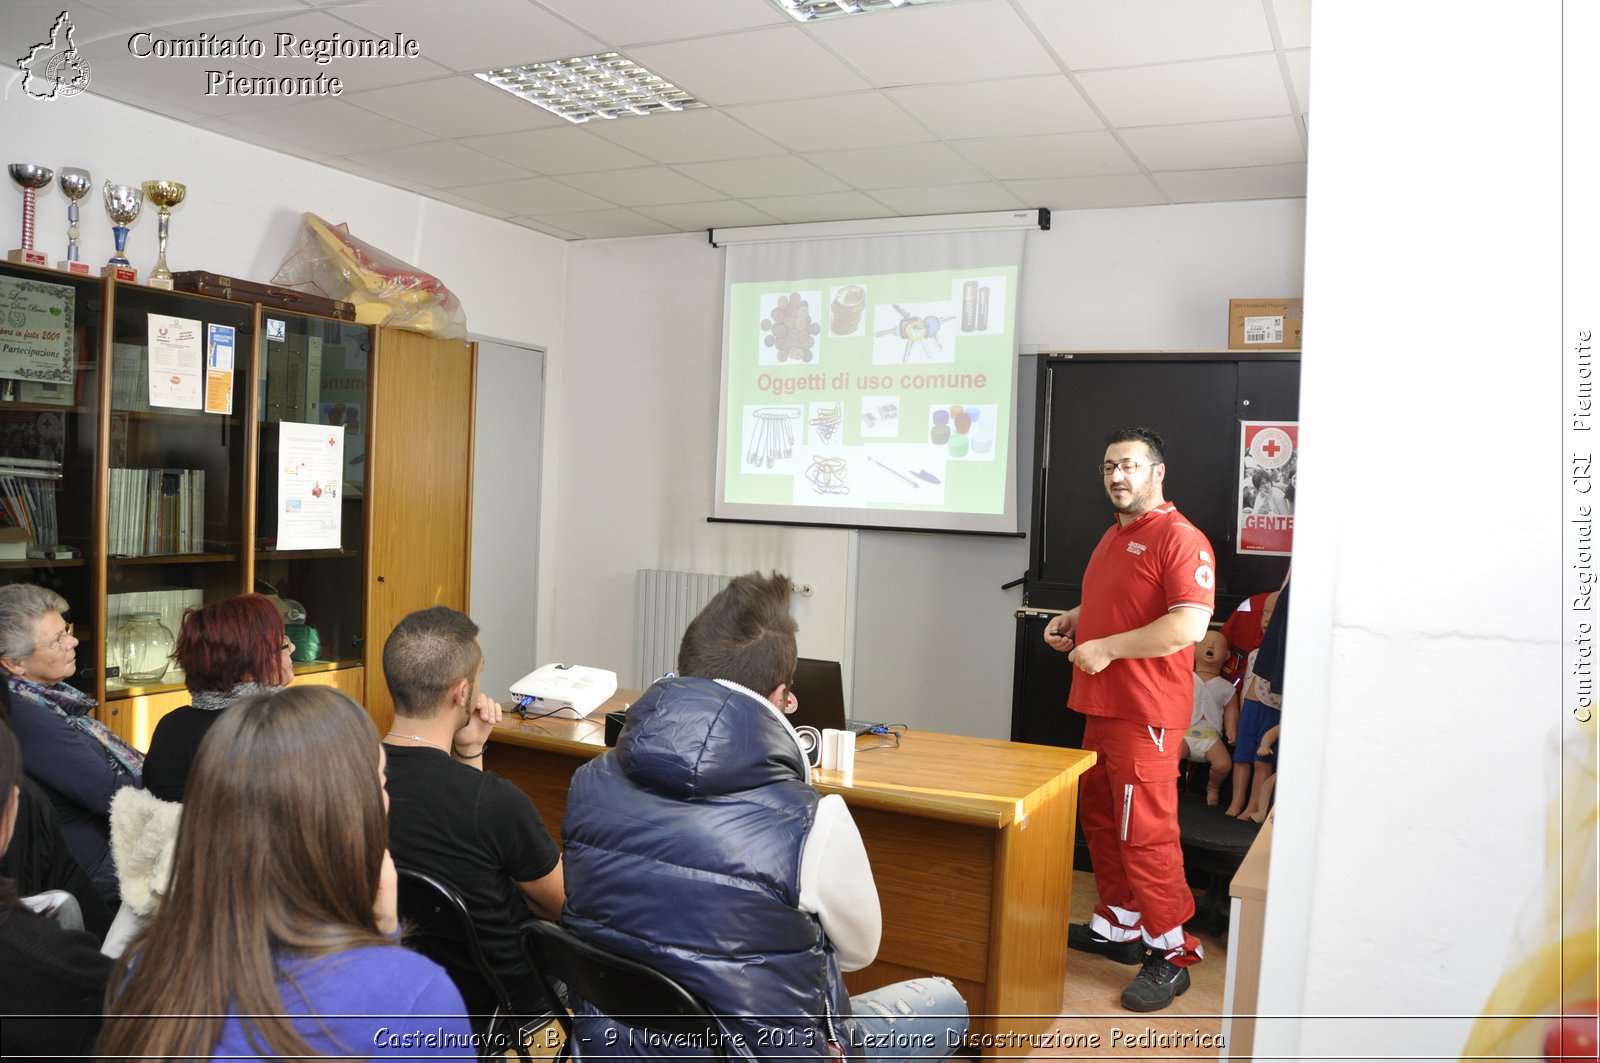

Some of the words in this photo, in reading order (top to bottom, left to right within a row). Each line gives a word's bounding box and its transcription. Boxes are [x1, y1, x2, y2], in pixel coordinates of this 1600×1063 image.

[24, 329, 39, 341] festa
[42, 330, 61, 341] 2009
[2, 343, 61, 358] Partecipazione
[757, 372, 827, 395] Oggetti
[831, 371, 850, 390] di
[856, 375, 894, 390] uso
[900, 372, 987, 390] comune
[1246, 515, 1294, 530] GENTE
